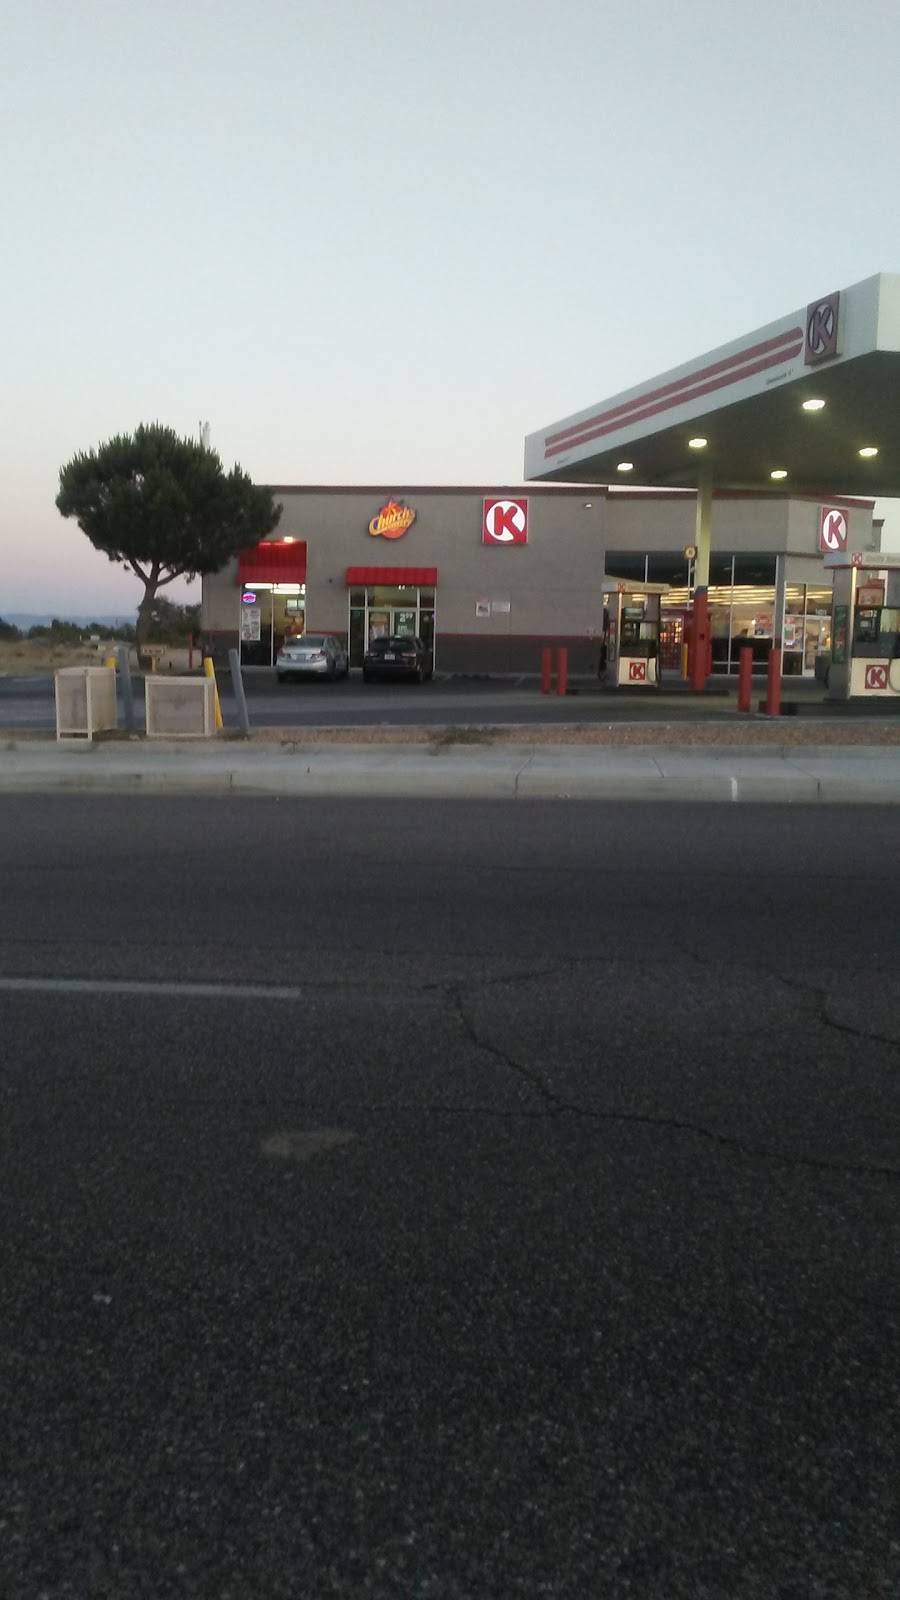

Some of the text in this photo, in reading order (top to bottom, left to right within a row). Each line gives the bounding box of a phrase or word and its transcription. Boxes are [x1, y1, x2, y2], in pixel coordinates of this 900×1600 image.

[812, 306, 833, 352] K
[494, 506, 521, 540] K
[827, 514, 847, 546] K
[632, 664, 645, 679] K
[869, 668, 886, 687] K
